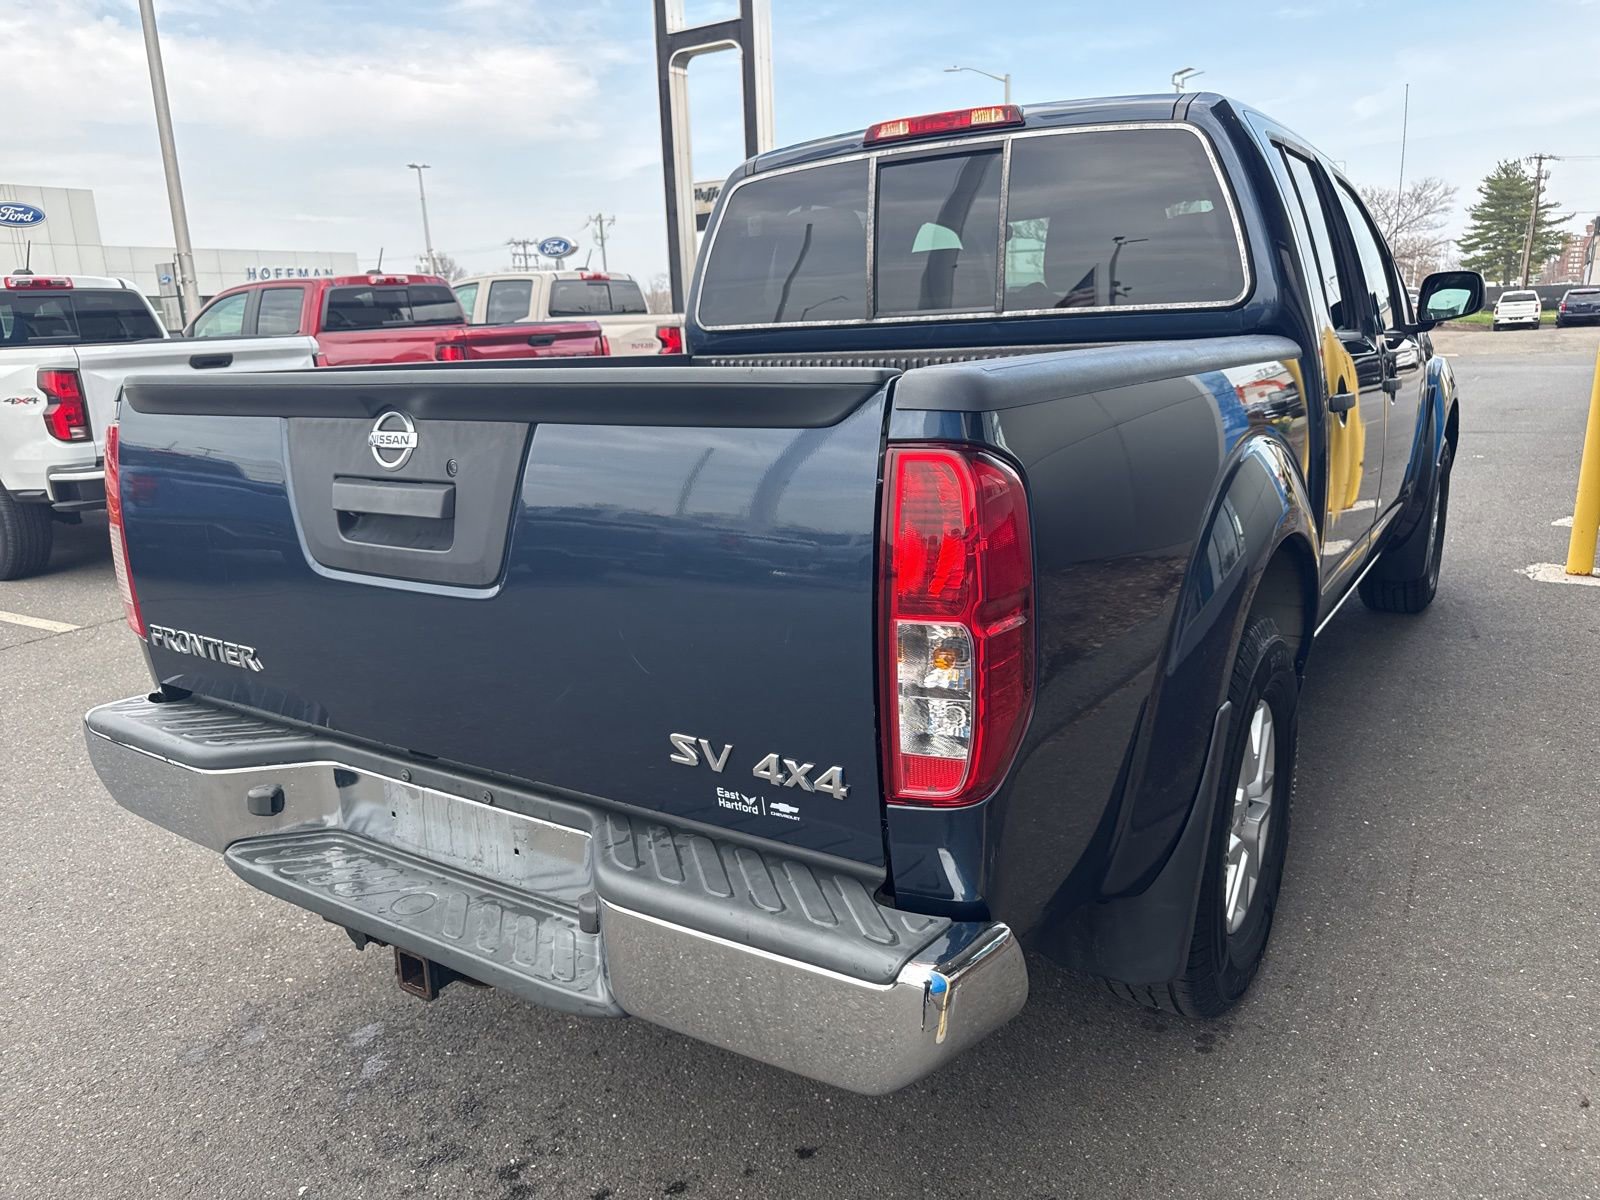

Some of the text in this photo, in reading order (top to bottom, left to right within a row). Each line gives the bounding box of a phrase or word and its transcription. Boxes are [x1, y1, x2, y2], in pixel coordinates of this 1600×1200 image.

[0, 206, 34, 221] Ford
[544, 240, 566, 254] Ford
[247, 267, 334, 281] HOFFMAN
[369, 434, 410, 445] NISSAN
[150, 623, 264, 672] FRONTIER
[670, 733, 734, 773] SV
[716, 787, 740, 800] East
[718, 797, 759, 815] Hartford
[770, 811, 801, 821] CHEVROLET
